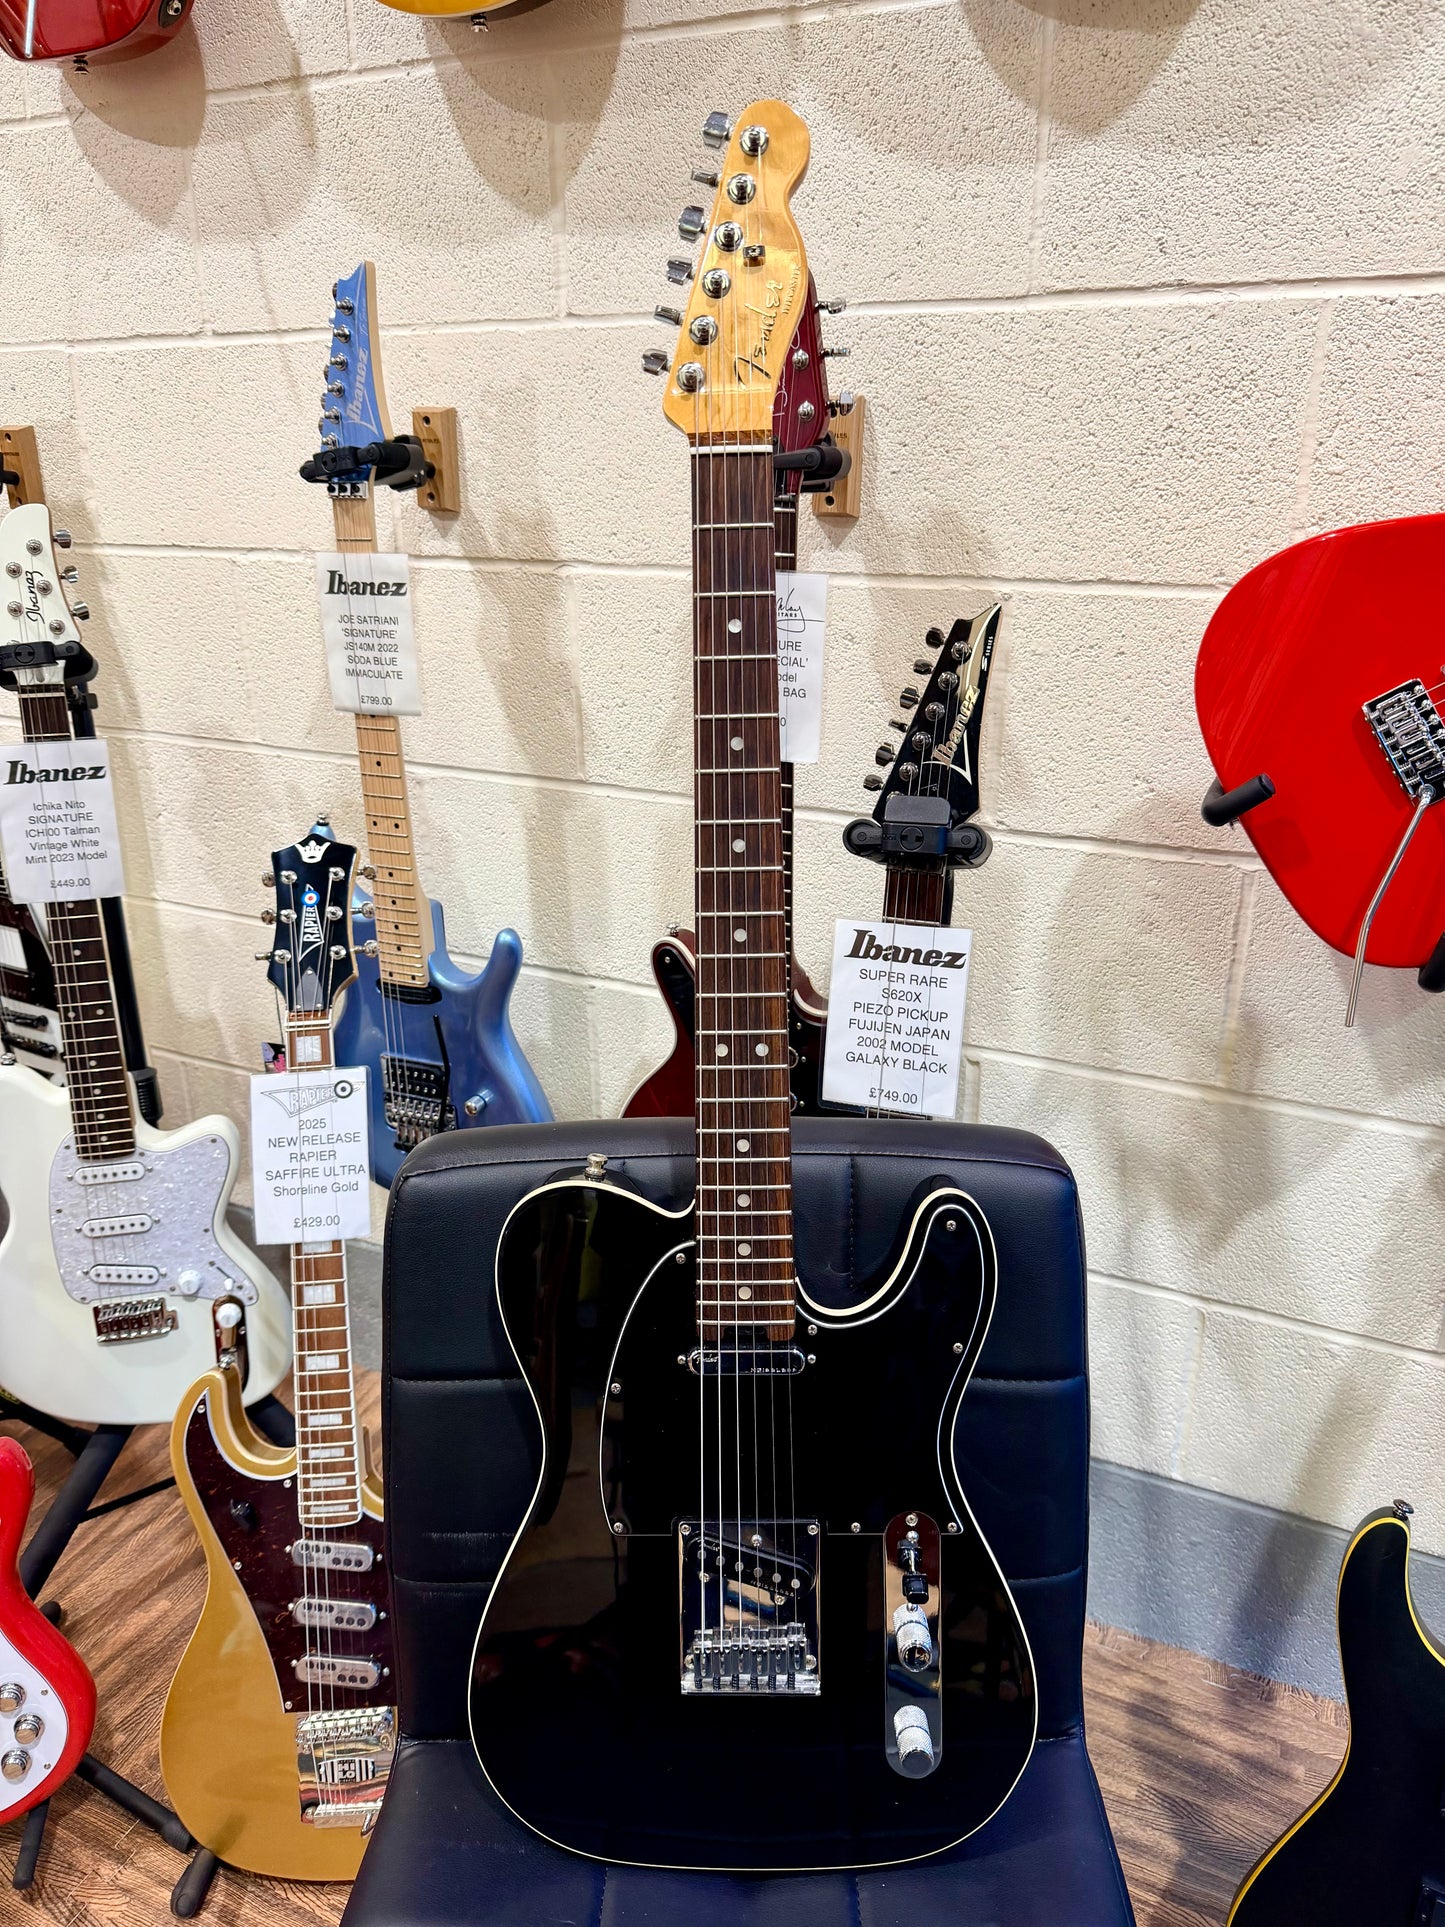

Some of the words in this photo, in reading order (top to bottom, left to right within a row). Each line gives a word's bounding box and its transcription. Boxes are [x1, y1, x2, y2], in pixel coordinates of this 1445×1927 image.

[734, 280, 783, 391] Fender
[346, 347, 369, 423] Ibanez
[324, 570, 408, 596] Ibanez
[338, 614, 356, 624] JOE
[357, 615, 399, 626] SATRIANI
[344, 642, 375, 652] JS140M
[378, 643, 399, 653] 2022
[778, 640, 802, 652] URE
[347, 655, 372, 665] SODA
[374, 656, 398, 666] BLUE
[345, 668, 403, 680] IMMACULATE
[361, 695, 393, 706] £799.00
[783, 687, 807, 699] BAG
[931, 685, 980, 770] Ibanez
[3, 759, 106, 786] Ibanez
[33, 802, 62, 812] Ichika
[65, 801, 86, 810] Nito
[28, 812, 94, 825] SIGNATURE
[62, 826, 101, 836] Talman
[29, 841, 68, 852] Vintage
[71, 839, 100, 849] White
[25, 855, 48, 865] Mint
[50, 853, 75, 863] 2023
[77, 851, 108, 861] Model
[50, 877, 91, 889] £449.00
[303, 905, 315, 942] RAPIER
[844, 929, 967, 970] Ibanez
[859, 969, 906, 984] SUPER
[909, 974, 949, 989] RARE
[881, 988, 922, 1003] S620X
[853, 1002, 894, 1017] PIEZO
[897, 1007, 949, 1023] PICKUP
[905, 1025, 951, 1041] JAPAN
[857, 1036, 887, 1049] 2002
[890, 1041, 939, 1057] MODEL
[845, 1051, 900, 1068] GALAXY
[902, 1059, 948, 1075] BLACK
[289, 1087, 334, 1112] RAPIER
[869, 1087, 918, 1104] £749.00
[299, 1118, 327, 1130] 2025
[268, 1136, 298, 1148] NEW
[301, 1132, 361, 1146] RELEASE
[289, 1150, 337, 1163] RAPIER
[265, 1167, 319, 1181] SAFFIRE
[323, 1164, 366, 1177] ULTRA
[273, 1184, 328, 1197] Shoreline
[331, 1181, 359, 1193] Gold
[293, 1215, 340, 1228] £429.00
